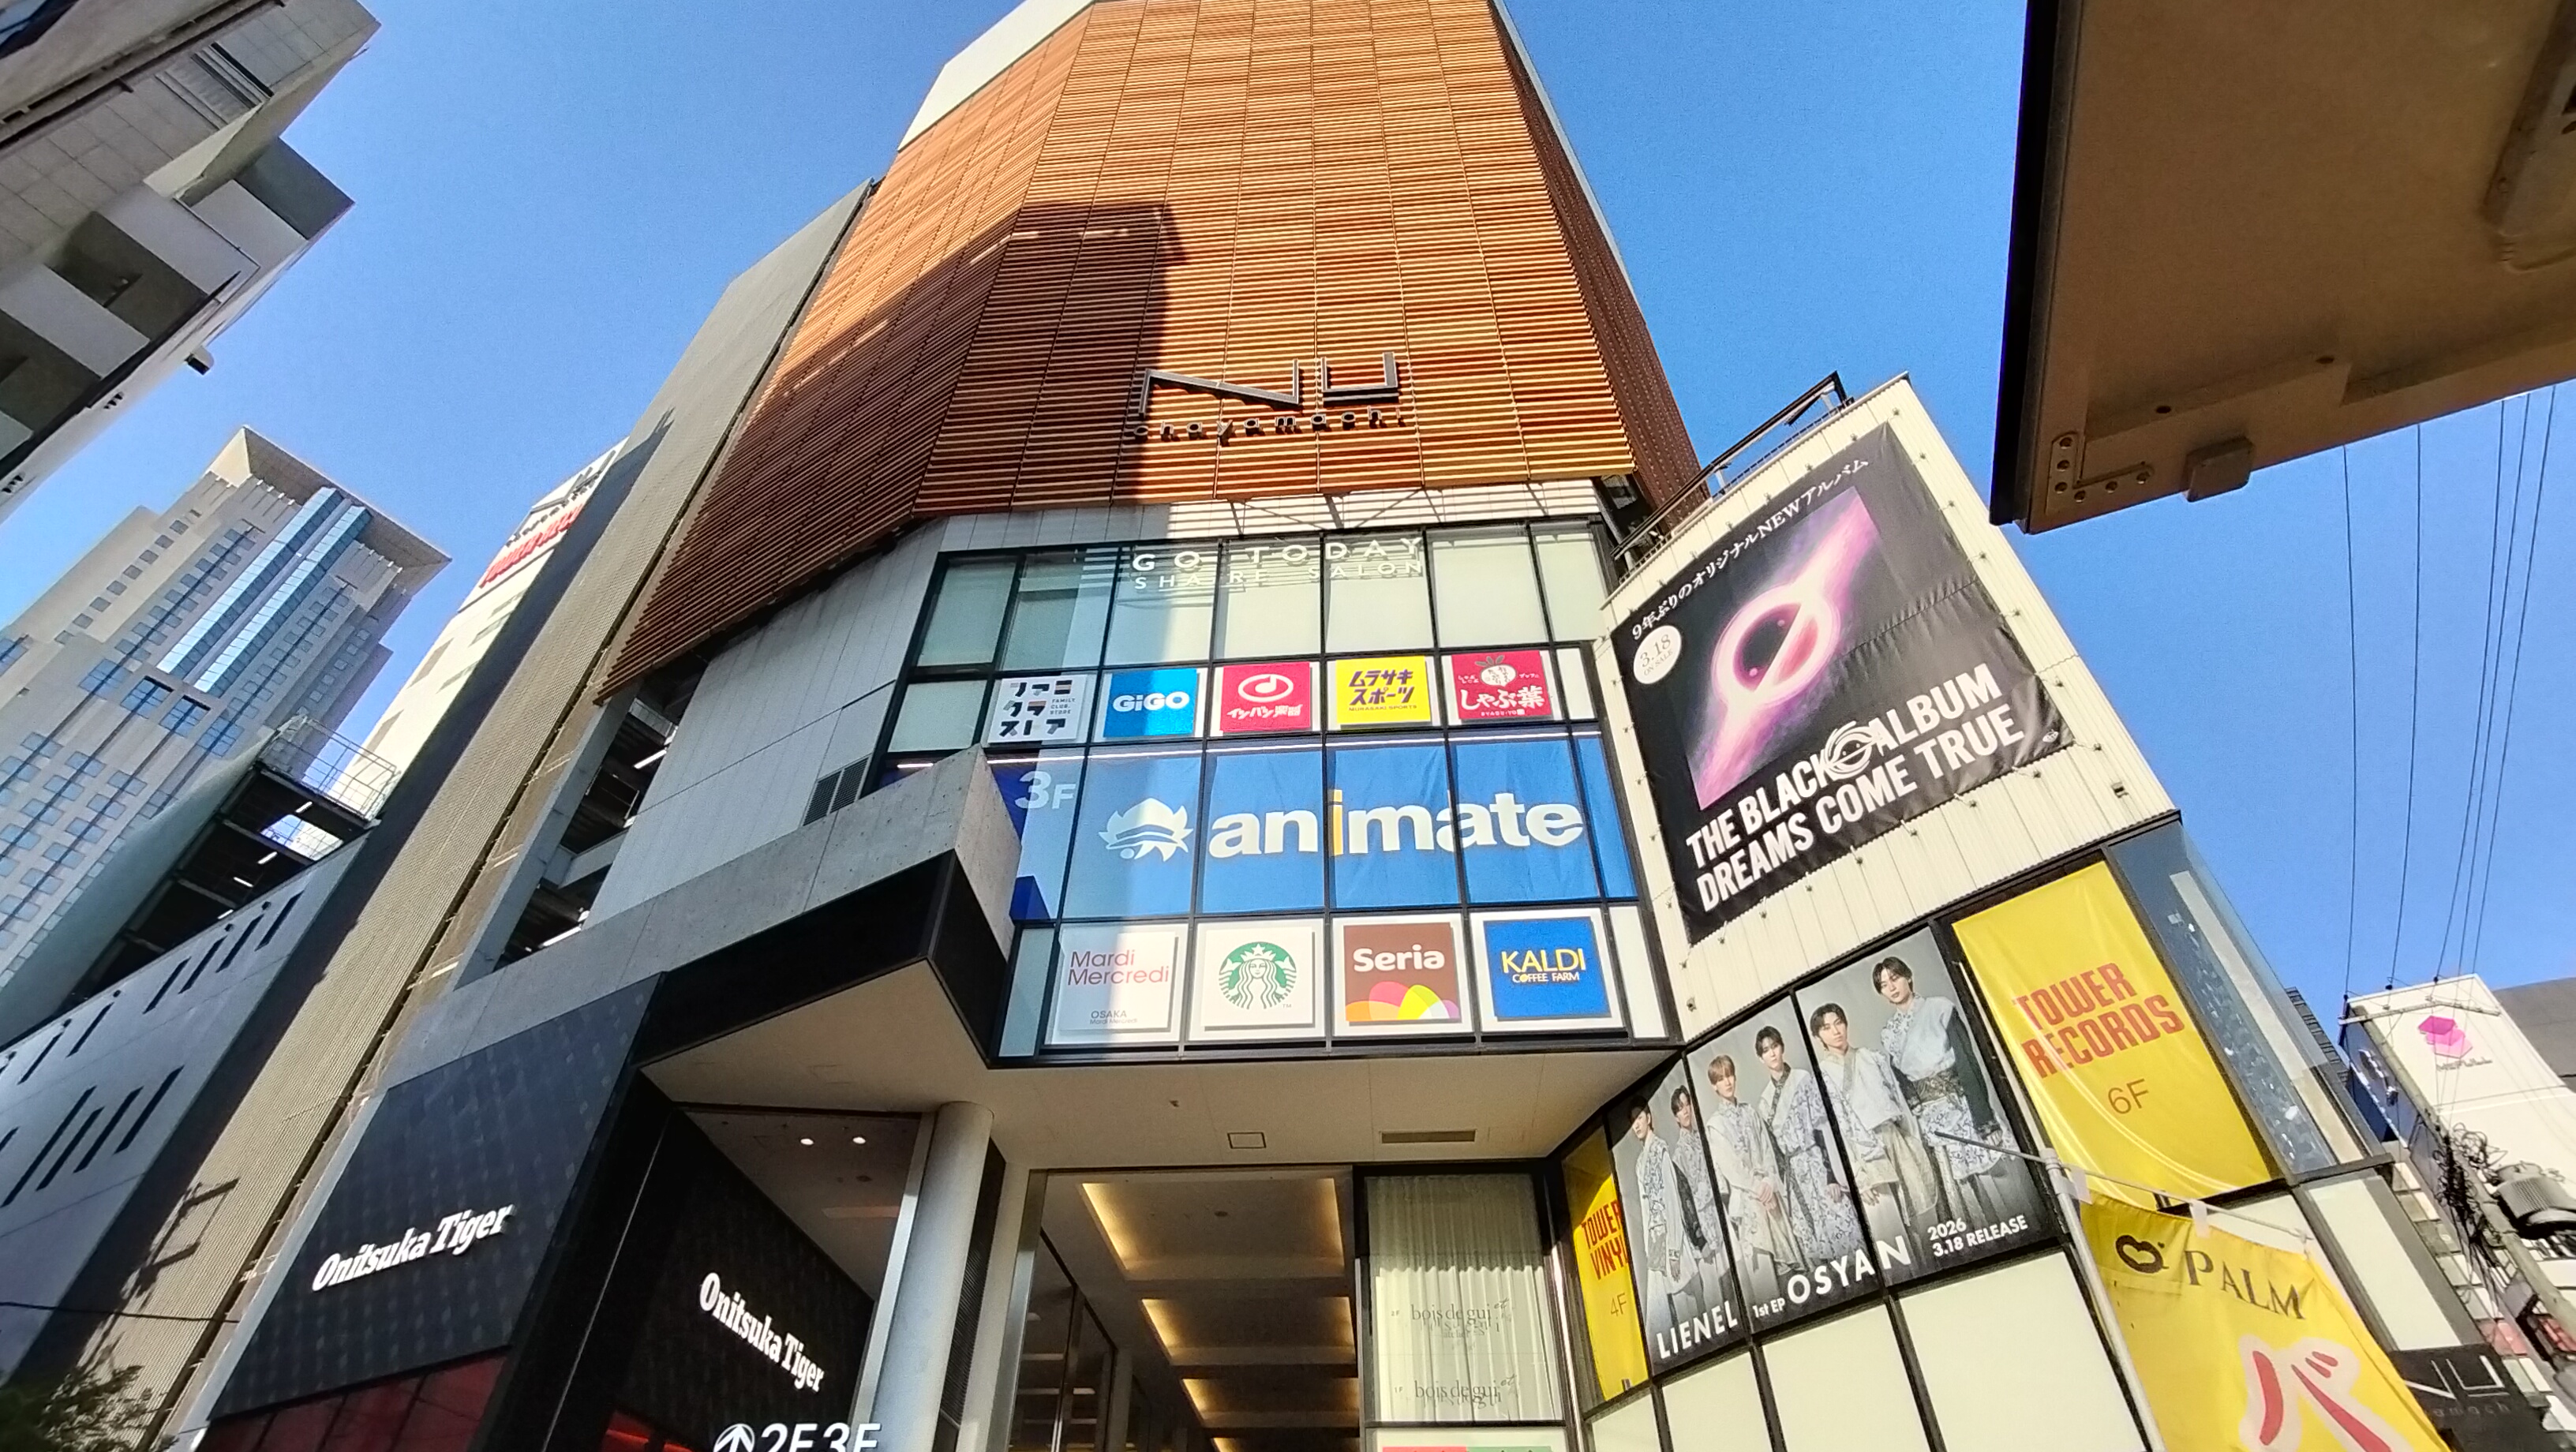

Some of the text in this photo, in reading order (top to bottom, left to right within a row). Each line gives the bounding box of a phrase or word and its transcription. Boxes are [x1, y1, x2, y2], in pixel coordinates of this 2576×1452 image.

[1139, 351, 1400, 413] NU
[1133, 406, 1402, 442] chayamachi
[1132, 537, 1422, 571] GO TODAY
[1632, 459, 1869, 641] 9年ぶりのオリジナルNEWアルバム
[1134, 561, 1422, 589] SHARE SALON
[1640, 634, 1671, 668] 3.18
[1349, 668, 1413, 687] ムラサキ
[1112, 691, 1189, 712] GiGO
[1350, 686, 1414, 705] スポーツ
[1460, 685, 1544, 710] しゃぶ葉
[1686, 663, 2002, 868] THE BLACK ALBUM
[1014, 771, 1076, 810] 3F
[1208, 790, 1583, 859] animate
[1696, 703, 2025, 913] DREAMS COME TRUE
[1070, 949, 1135, 967] Mardi
[1354, 944, 1445, 972] Seria
[1501, 949, 1586, 973] KALDI
[1068, 966, 1169, 986] Mercredi
[1512, 971, 1580, 983] COFFEE FARM
[2012, 962, 2137, 1031] TOWER
[1091, 1010, 1127, 1019] OSAKA
[2020, 994, 2185, 1079] RECORDS
[2107, 1078, 2149, 1114] 6F
[1926, 1218, 1968, 1242] 2026
[1931, 1214, 2028, 1258] 3.18 RELEASE
[312, 1204, 515, 1292] Onitsuka Tiger
[1657, 1235, 1911, 1360] LIENEL 1st EP OSYAN
[2185, 1249, 2306, 1320] PALM
[1410, 1304, 1492, 1326] bois de gui
[1610, 1293, 1627, 1317] 4F
[699, 1272, 825, 1392] Onitsuka Tiger
[1414, 1379, 1498, 1403] bois de gui
